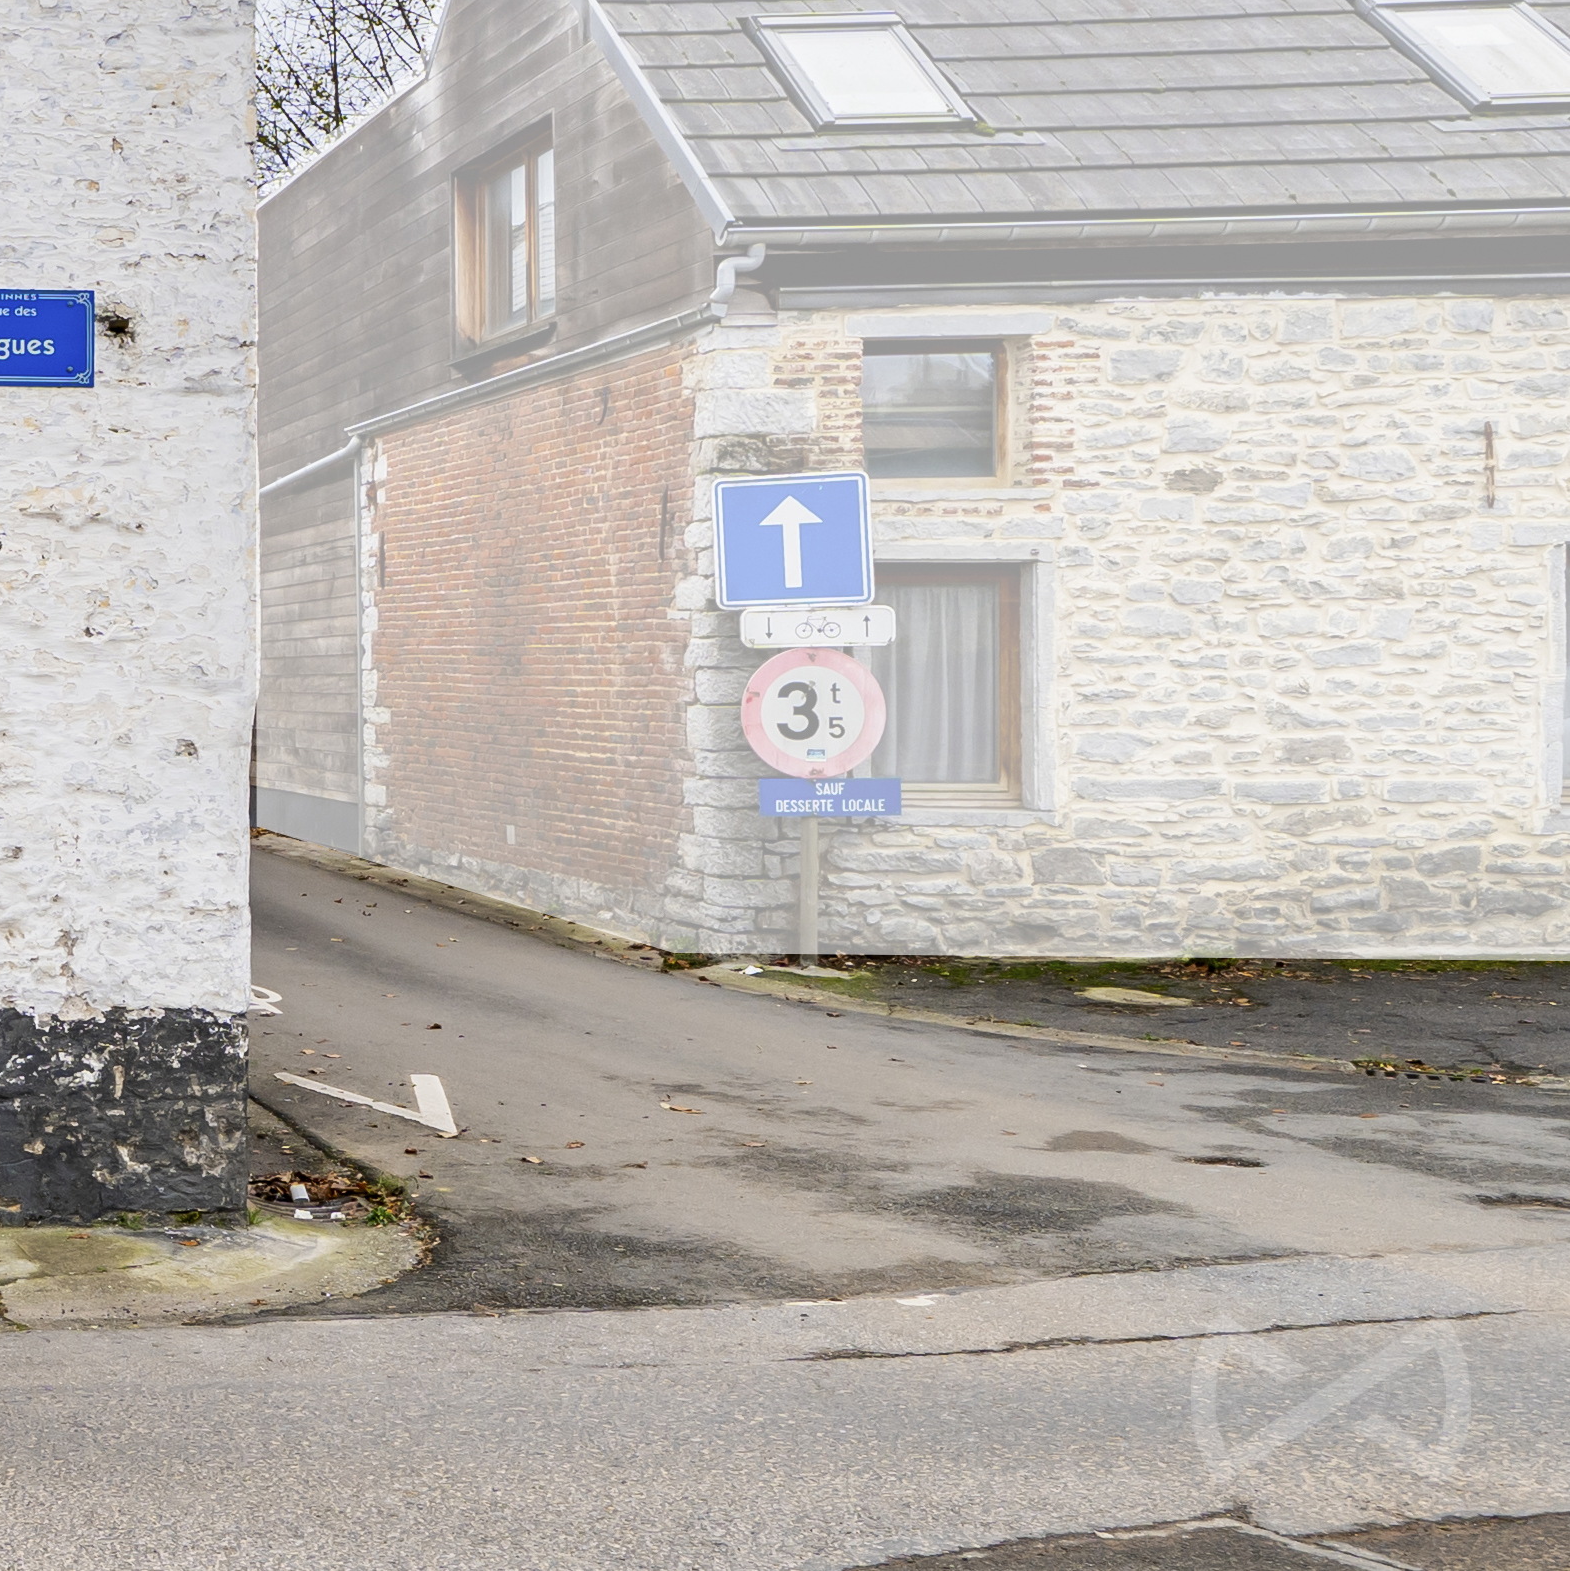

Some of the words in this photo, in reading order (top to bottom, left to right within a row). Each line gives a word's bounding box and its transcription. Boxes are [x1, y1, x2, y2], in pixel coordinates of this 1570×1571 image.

[14, 305, 37, 317] des
[776, 681, 820, 741] 3
[828, 716, 846, 739] 5
[815, 782, 845, 795] SAUF
[775, 799, 834, 812] DESSERTE
[842, 798, 886, 811] LOCALE
